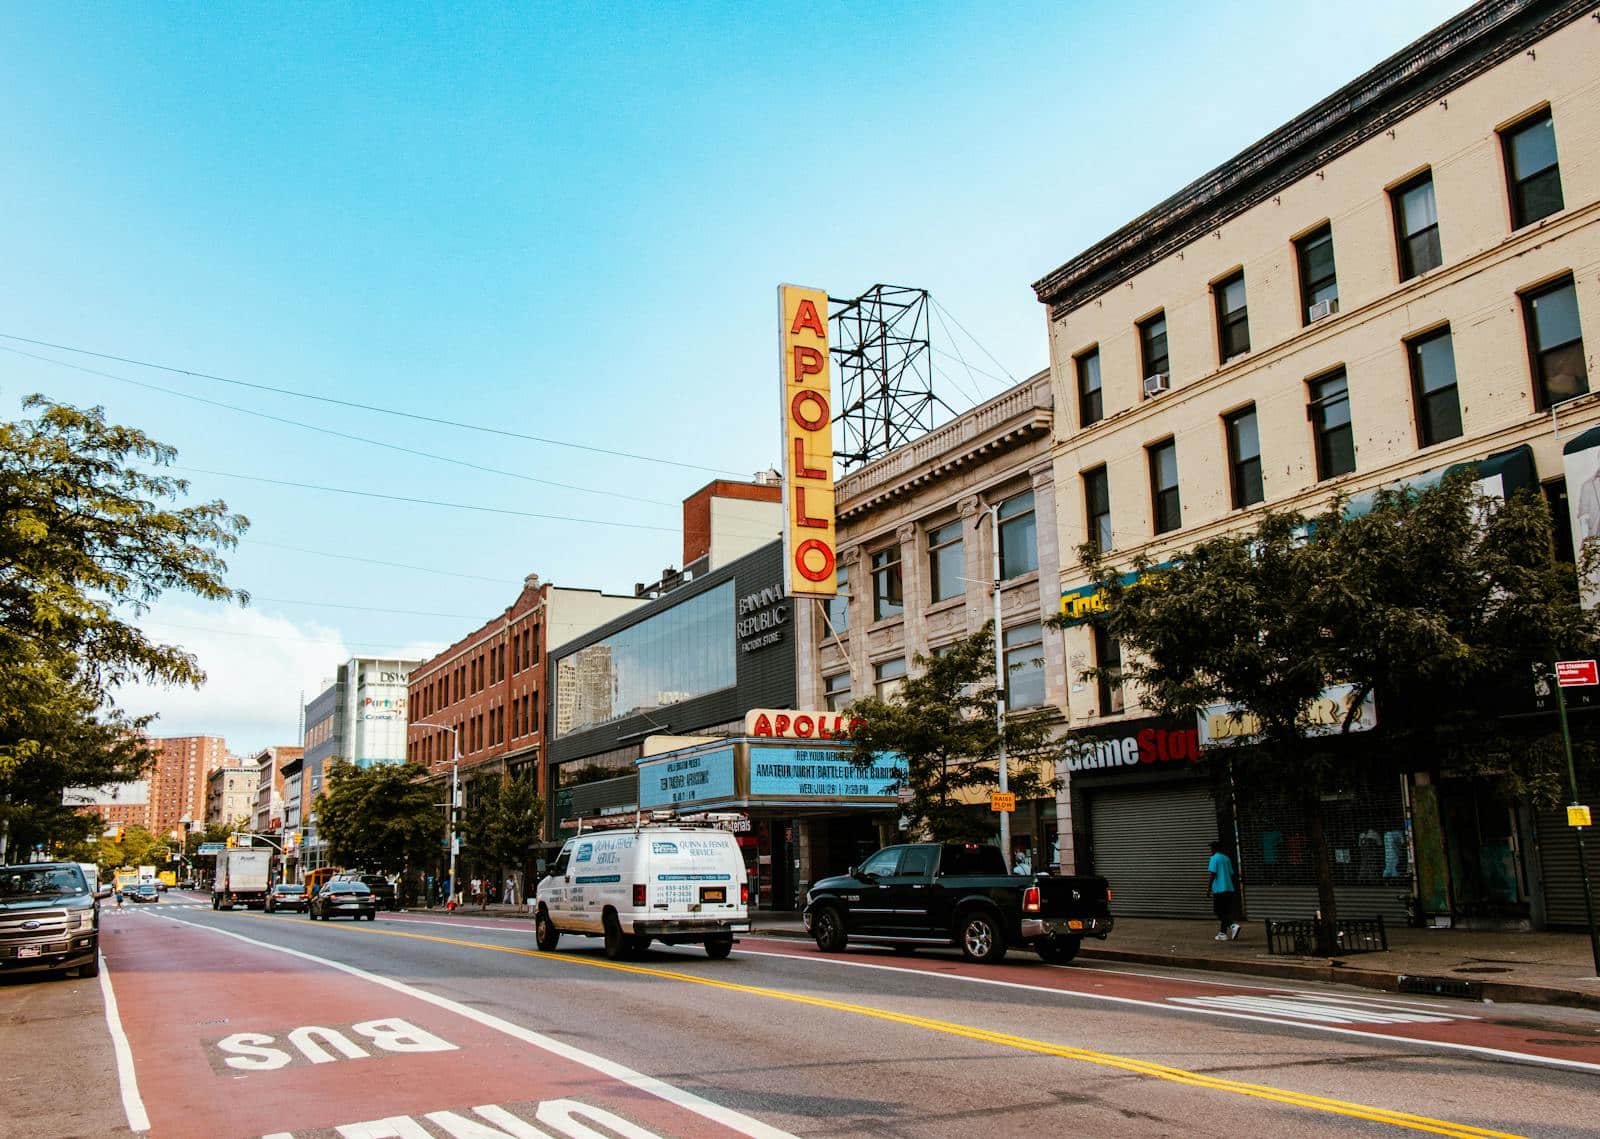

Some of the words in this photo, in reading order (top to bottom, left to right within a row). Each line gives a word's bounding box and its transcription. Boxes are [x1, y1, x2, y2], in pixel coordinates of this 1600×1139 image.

[791, 299, 835, 582] APOLLO
[739, 584, 784, 615] BANANA
[736, 606, 786, 639] REPUBLIC
[757, 764, 791, 777] AMATEUR
[793, 765, 815, 778] NIGHT
[817, 765, 843, 779] BATTLE
[844, 766, 855, 779] OF
[216, 1017, 460, 1070] BUS
